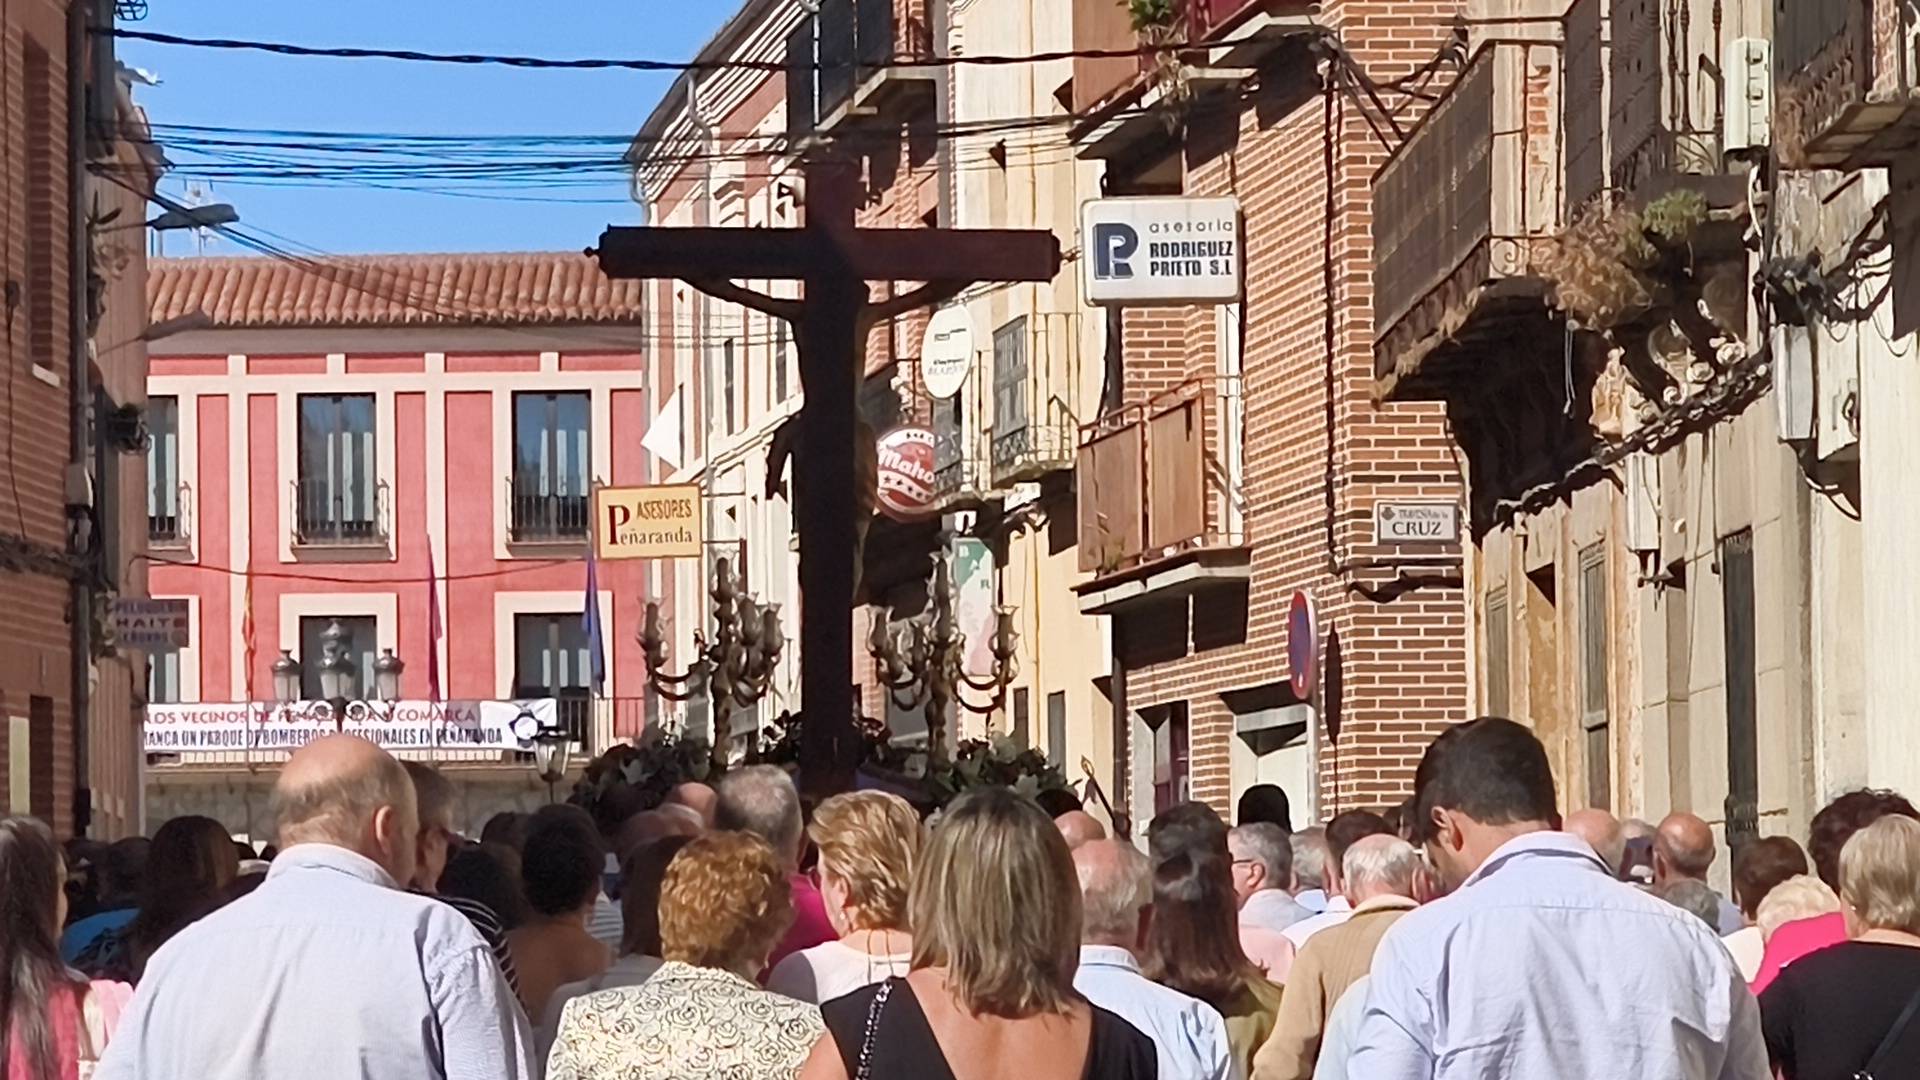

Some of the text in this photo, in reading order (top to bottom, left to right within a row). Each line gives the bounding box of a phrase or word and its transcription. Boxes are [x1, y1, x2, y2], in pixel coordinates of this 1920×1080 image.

[1149, 241, 1233, 259] RODRIGUEZ
[1150, 260, 1202, 277] PRIETO
[637, 499, 692, 519] ASESORES
[1392, 521, 1442, 536] CRUZ
[181, 711, 249, 723] VECINOS
[182, 730, 197, 746] UN
[200, 729, 243, 747] PARQUE
